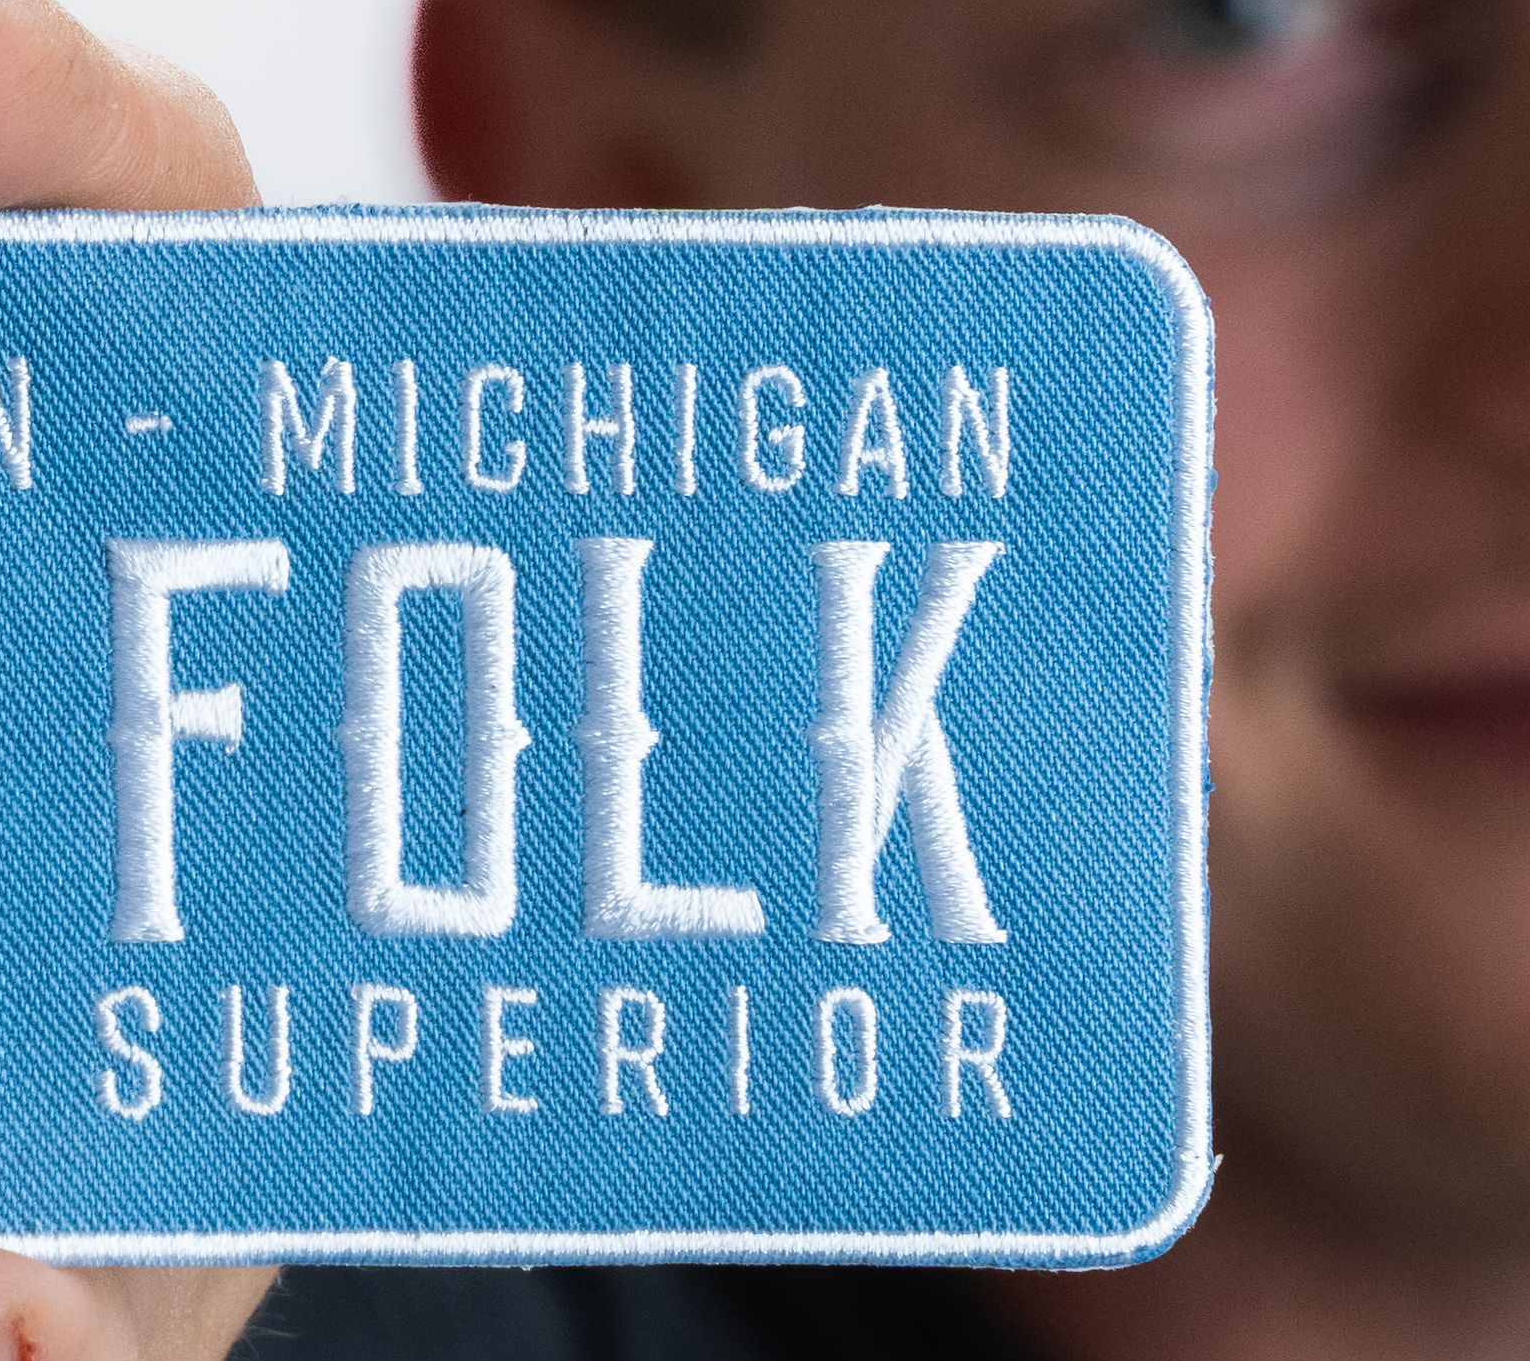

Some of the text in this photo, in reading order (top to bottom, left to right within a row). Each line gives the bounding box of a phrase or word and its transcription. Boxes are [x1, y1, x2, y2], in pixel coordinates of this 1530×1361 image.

[258, 353, 1016, 503] MICHIGAN
[106, 535, 1010, 949] FOLK
[93, 980, 1016, 1125] SUPERIOR
